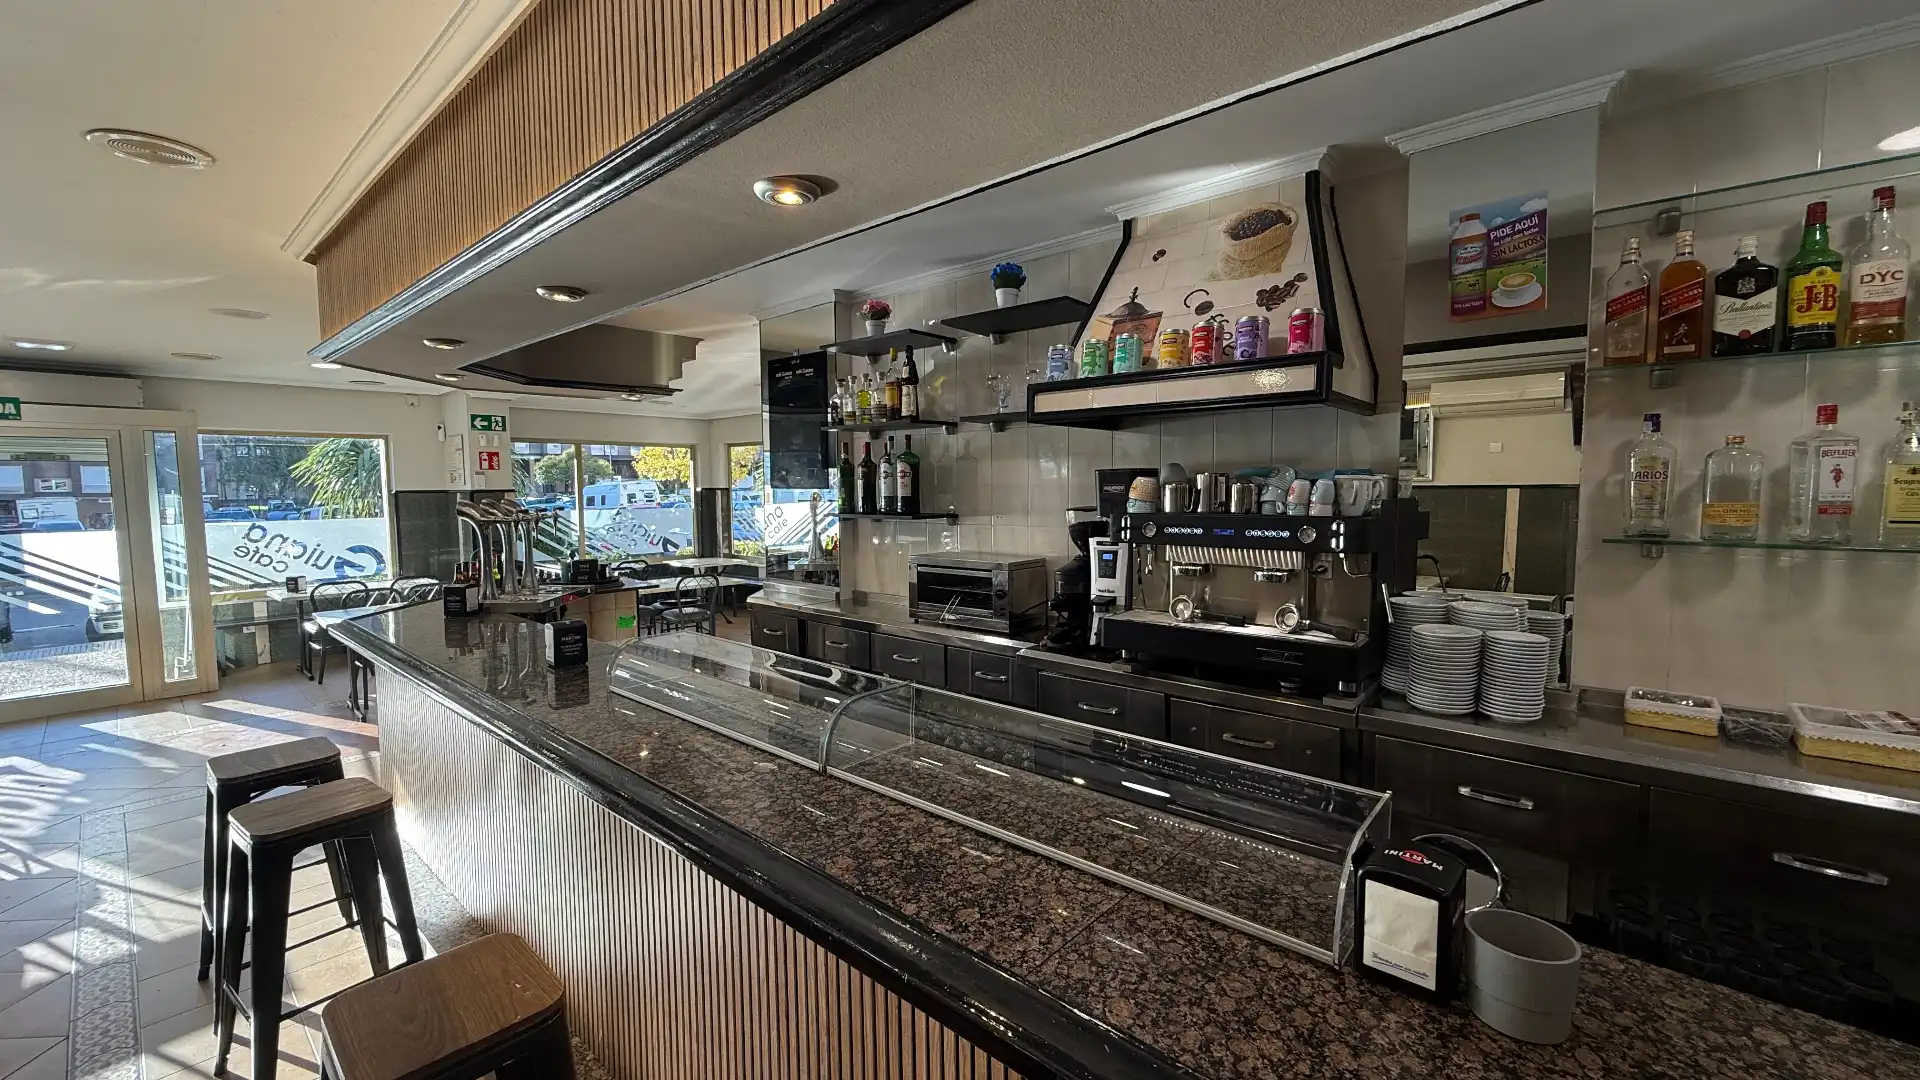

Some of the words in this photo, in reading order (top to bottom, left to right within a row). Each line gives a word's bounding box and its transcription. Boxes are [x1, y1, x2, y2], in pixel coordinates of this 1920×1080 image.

[1490, 225, 1513, 240] PIDE
[1514, 214, 1539, 232] AQUÍ
[1491, 246, 1507, 260] SIN
[1508, 235, 1545, 254] LACTOSA
[1860, 270, 1904, 285] DYC
[1679, 288, 1703, 299] LABEL
[1796, 283, 1837, 313] J&B
[1821, 449, 1857, 458] BEEFEATER
[1633, 470, 1669, 480] ARIOS
[1384, 849, 1444, 871] MARTINI
